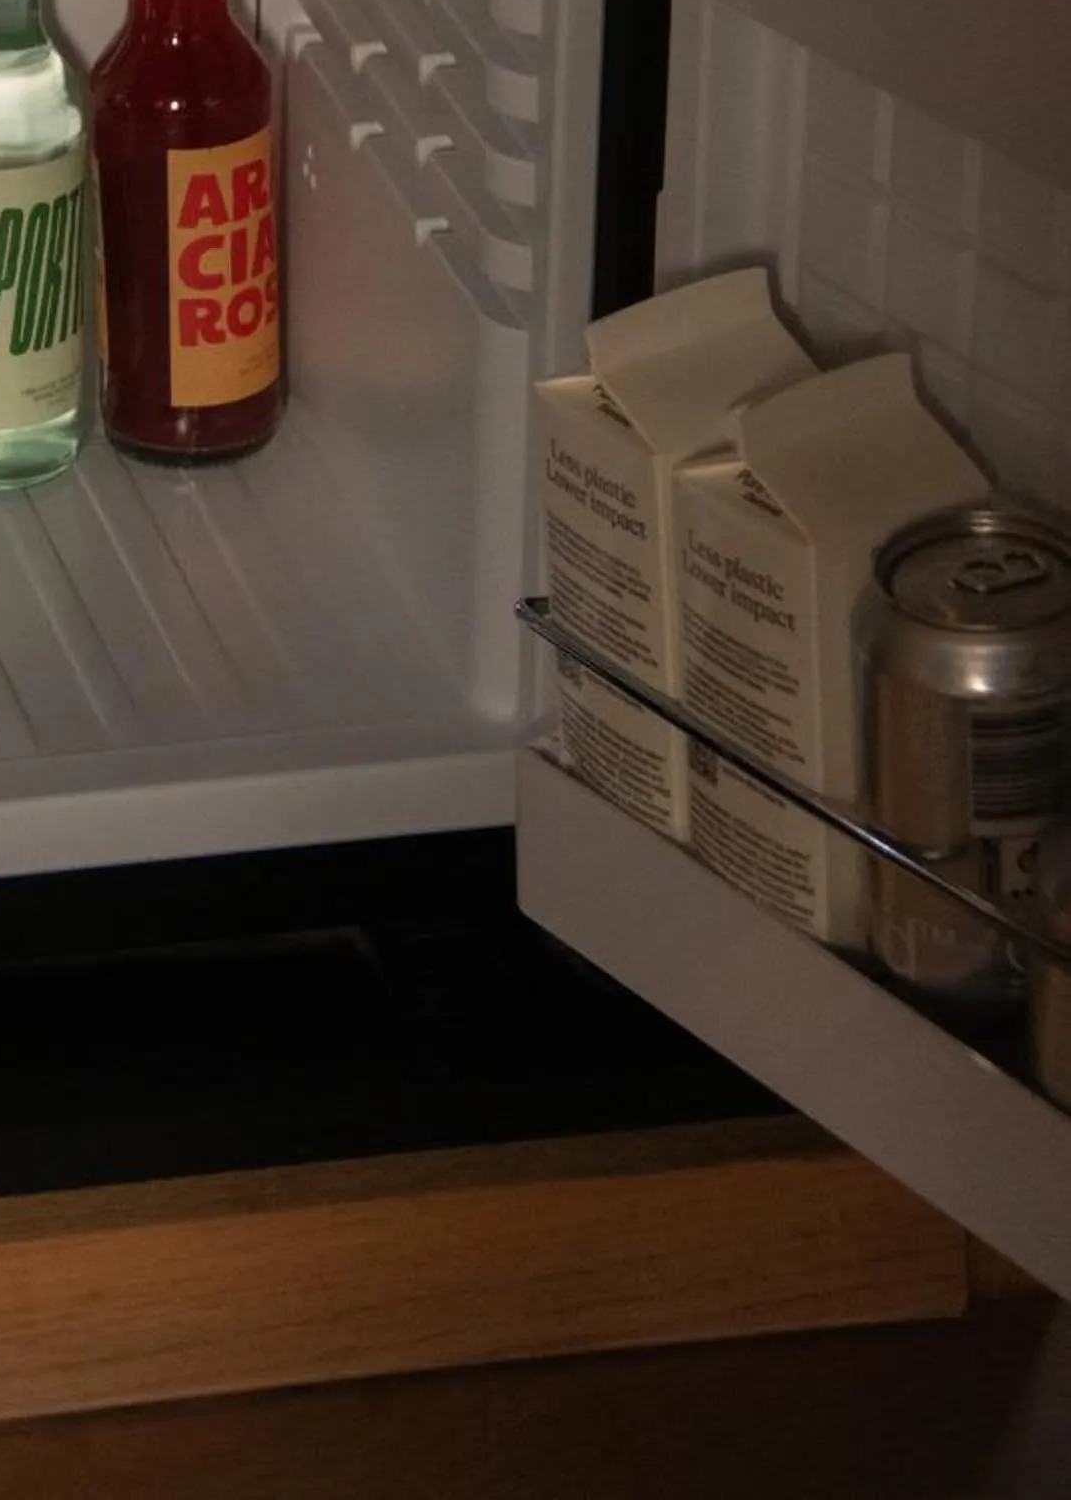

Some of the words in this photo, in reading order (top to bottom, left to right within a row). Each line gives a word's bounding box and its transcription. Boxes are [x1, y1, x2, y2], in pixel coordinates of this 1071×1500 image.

[178, 212, 274, 291] CIA
[546, 457, 587, 507] Lower
[589, 489, 648, 542] impact
[549, 437, 583, 480] Less
[584, 465, 636, 509] plastic
[681, 547, 728, 597] Lower
[730, 581, 797, 633] impact
[688, 528, 722, 568] Less
[724, 556, 785, 603] plastic
